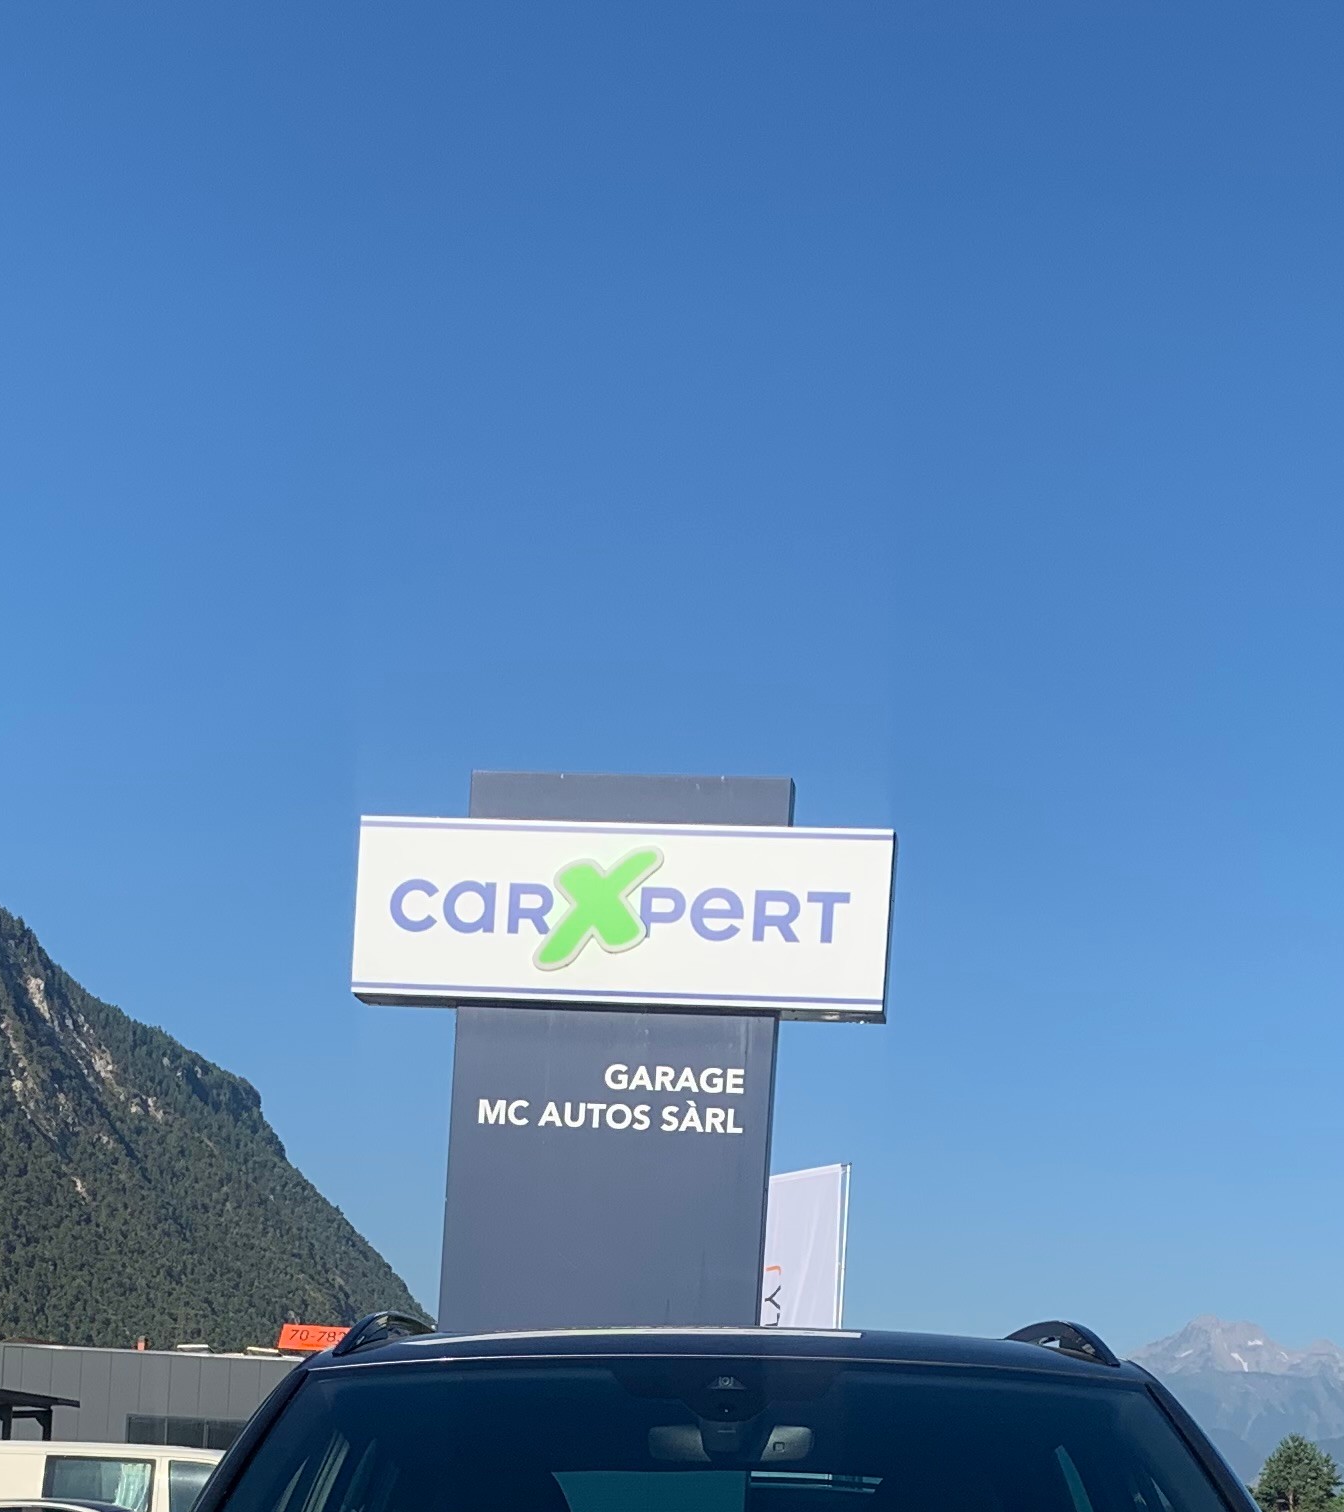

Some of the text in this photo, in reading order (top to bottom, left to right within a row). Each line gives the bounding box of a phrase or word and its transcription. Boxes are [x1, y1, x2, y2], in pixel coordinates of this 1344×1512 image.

[604, 1064, 745, 1094] GARAGE
[477, 1098, 744, 1134] MC AUTOS SÀRL
